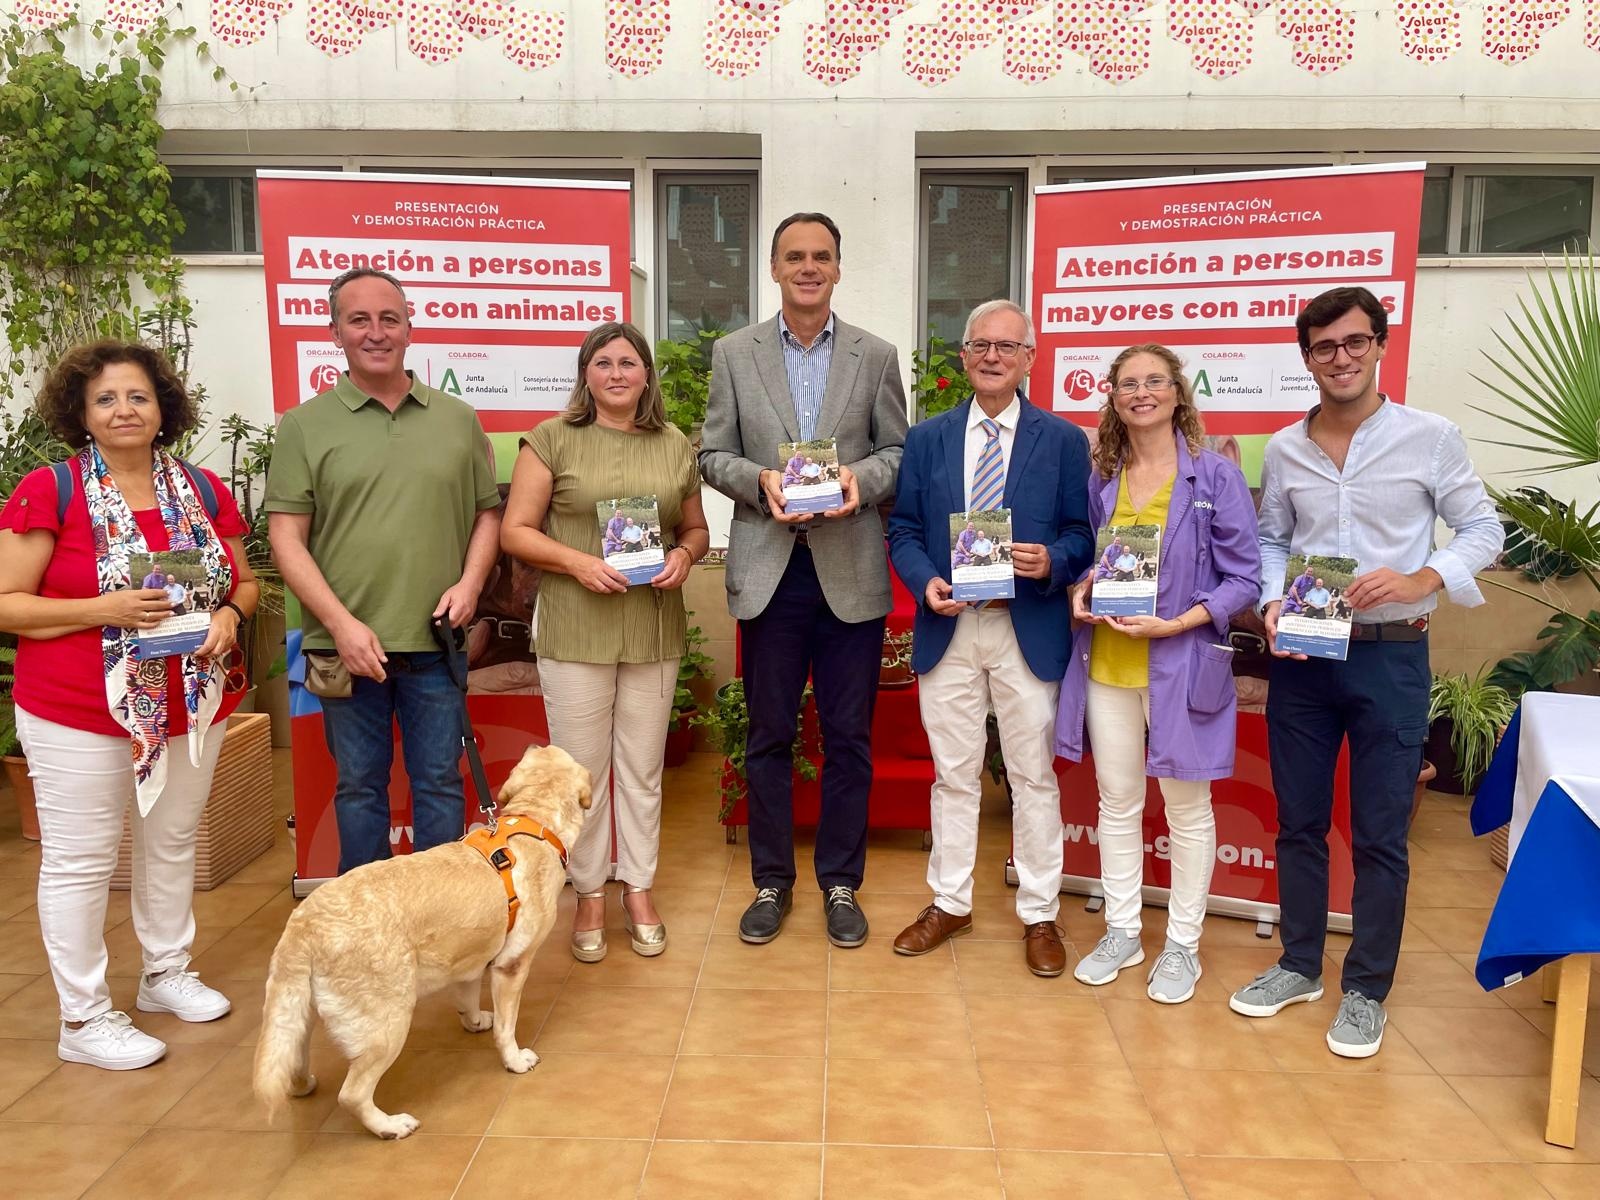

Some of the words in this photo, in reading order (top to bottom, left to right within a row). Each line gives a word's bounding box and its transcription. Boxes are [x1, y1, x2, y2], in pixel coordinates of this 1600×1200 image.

[351, 5, 393, 20] Solear
[1516, 11, 1561, 23] Solear
[111, 12, 150, 26] Solear
[461, 13, 504, 27] Solear
[1405, 16, 1449, 28] Solear
[216, 24, 256, 39] Solear
[616, 24, 661, 37] Solear
[725, 28, 770, 40] Solear
[1176, 25, 1222, 38] Solear
[1286, 23, 1331, 35] Solear
[314, 33, 354, 48] Solear
[835, 33, 880, 46] Solear
[947, 31, 992, 43] Solear
[1063, 31, 1108, 43] Solear
[413, 42, 453, 55] Solear
[1409, 44, 1450, 54] Solear
[1490, 43, 1531, 53] Solear
[511, 48, 552, 61] Solear
[1300, 53, 1343, 64] Solear
[613, 55, 652, 68] Solear
[710, 58, 750, 70] Solear
[1097, 62, 1139, 73] Solear
[1200, 57, 1241, 68] Solear
[811, 63, 850, 75] Solear
[910, 64, 950, 75] Solear
[1011, 63, 1051, 74] Solear
[395, 201, 499, 215] PRESENTACIÓN
[1163, 198, 1272, 214] PRESENTACIÓN
[352, 214, 361, 225] Y
[365, 214, 475, 228] DEMOSTRACIÓN
[479, 217, 546, 230] PRÁCTICA
[1119, 221, 1128, 231] Y
[1131, 214, 1244, 231] DEMOSTRACIÓN
[1249, 210, 1322, 225] PRÁCTICA
[296, 248, 434, 273] Atención
[443, 256, 460, 273] a
[468, 257, 602, 278] personas
[1061, 252, 1197, 278] Atención
[1206, 255, 1223, 272] a
[1233, 248, 1383, 275] personas
[425, 301, 478, 318] con
[487, 298, 617, 321] animales
[1047, 303, 1174, 326] mayores
[1183, 301, 1238, 319] con
[465, 374, 485, 382] Junta
[1217, 375, 1239, 383] Junta
[475, 385, 508, 394] Andalucía
[1226, 385, 1263, 394] Andalucía
